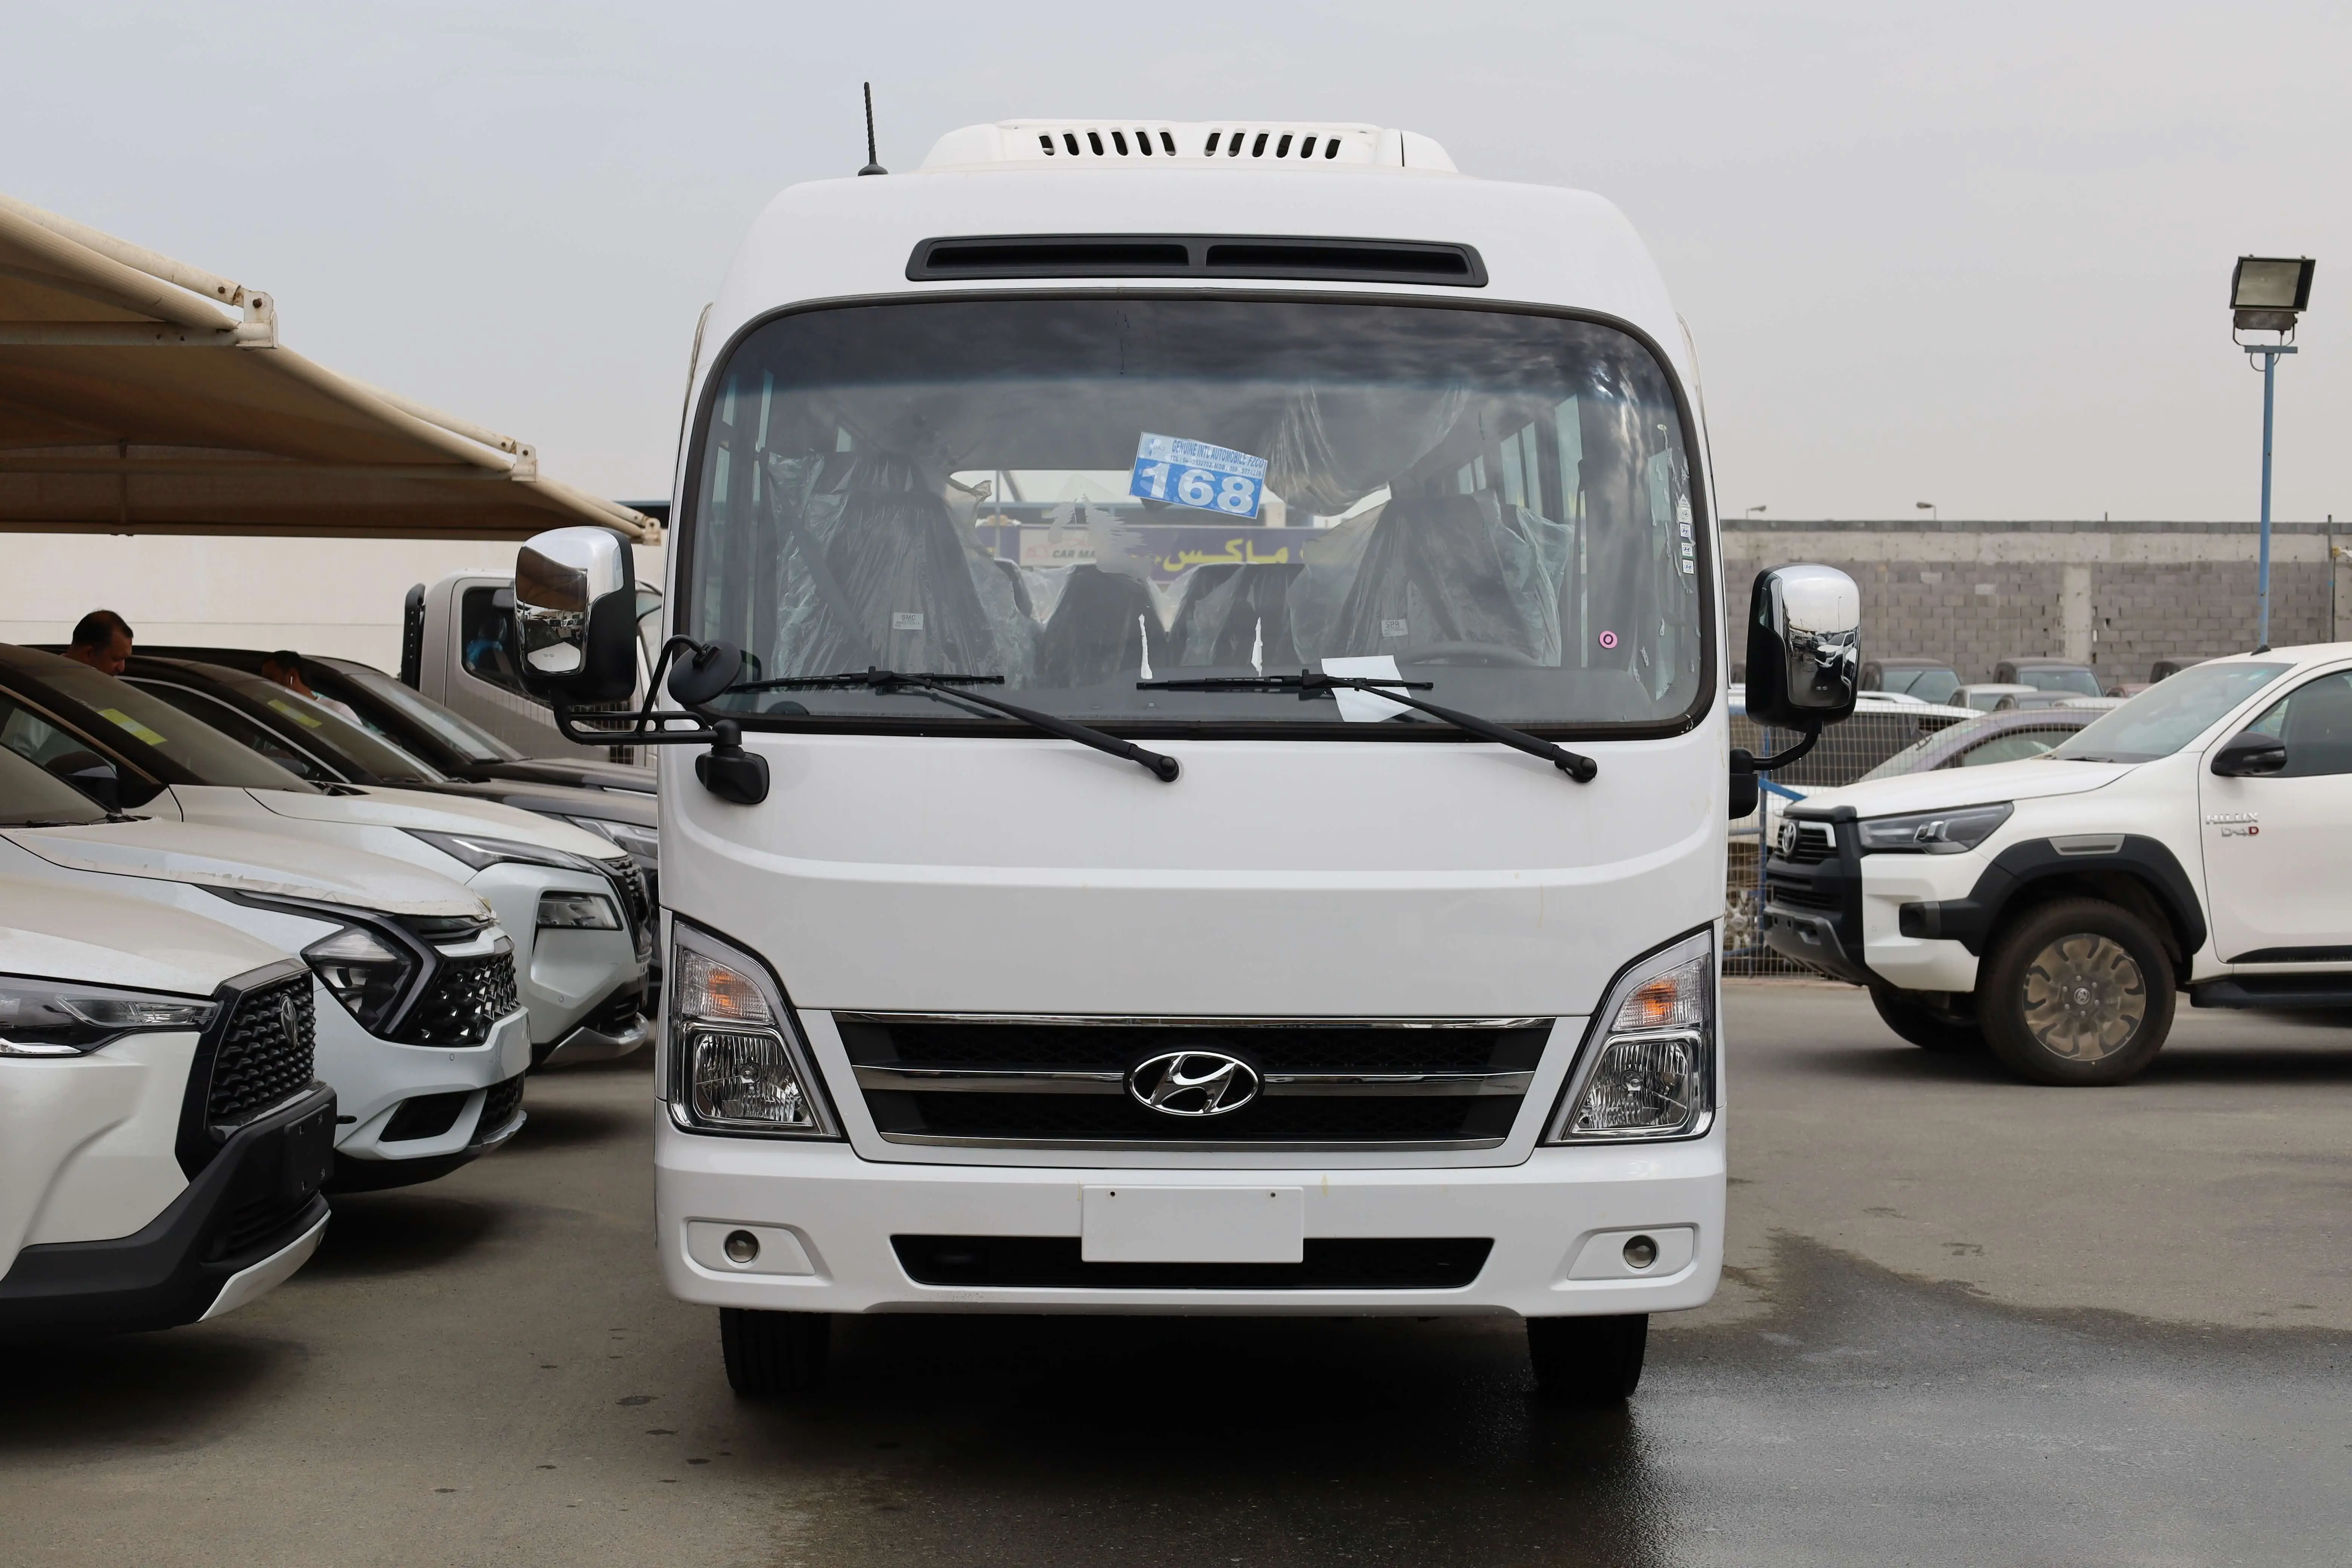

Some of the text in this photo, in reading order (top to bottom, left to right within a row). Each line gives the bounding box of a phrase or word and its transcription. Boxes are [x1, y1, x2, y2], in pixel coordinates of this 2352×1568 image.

[1172, 439, 1265, 468] GENUINE INTL AUTOMOBILE FZCO
[1142, 462, 1254, 513] 168
[1053, 549, 1076, 558] CAR
[2206, 812, 2259, 824] HILUX
